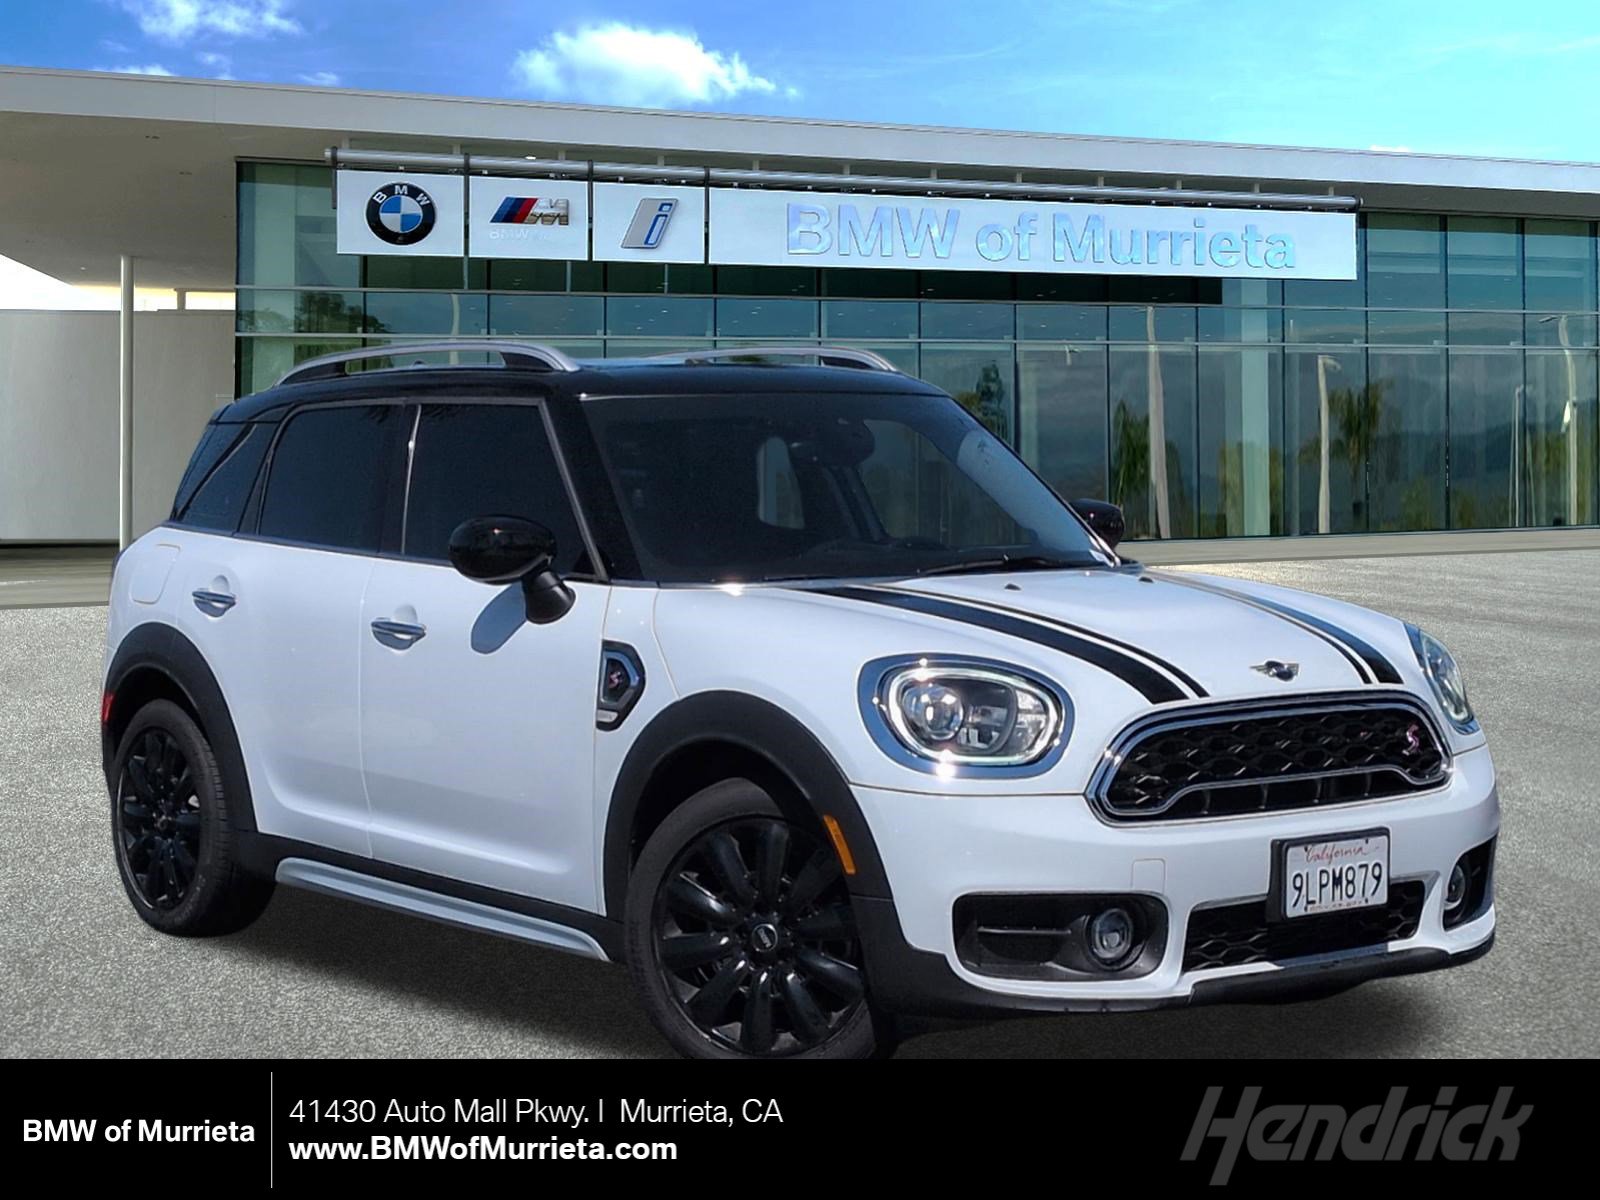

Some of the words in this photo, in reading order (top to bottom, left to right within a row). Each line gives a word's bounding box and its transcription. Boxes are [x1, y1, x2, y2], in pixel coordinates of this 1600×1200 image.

[372, 185, 431, 206] BMW
[786, 202, 960, 258] BMW
[975, 211, 1038, 263] of
[1051, 213, 1296, 270] Murrieta
[1306, 843, 1369, 865] California
[1292, 862, 1383, 908] 9LPM879
